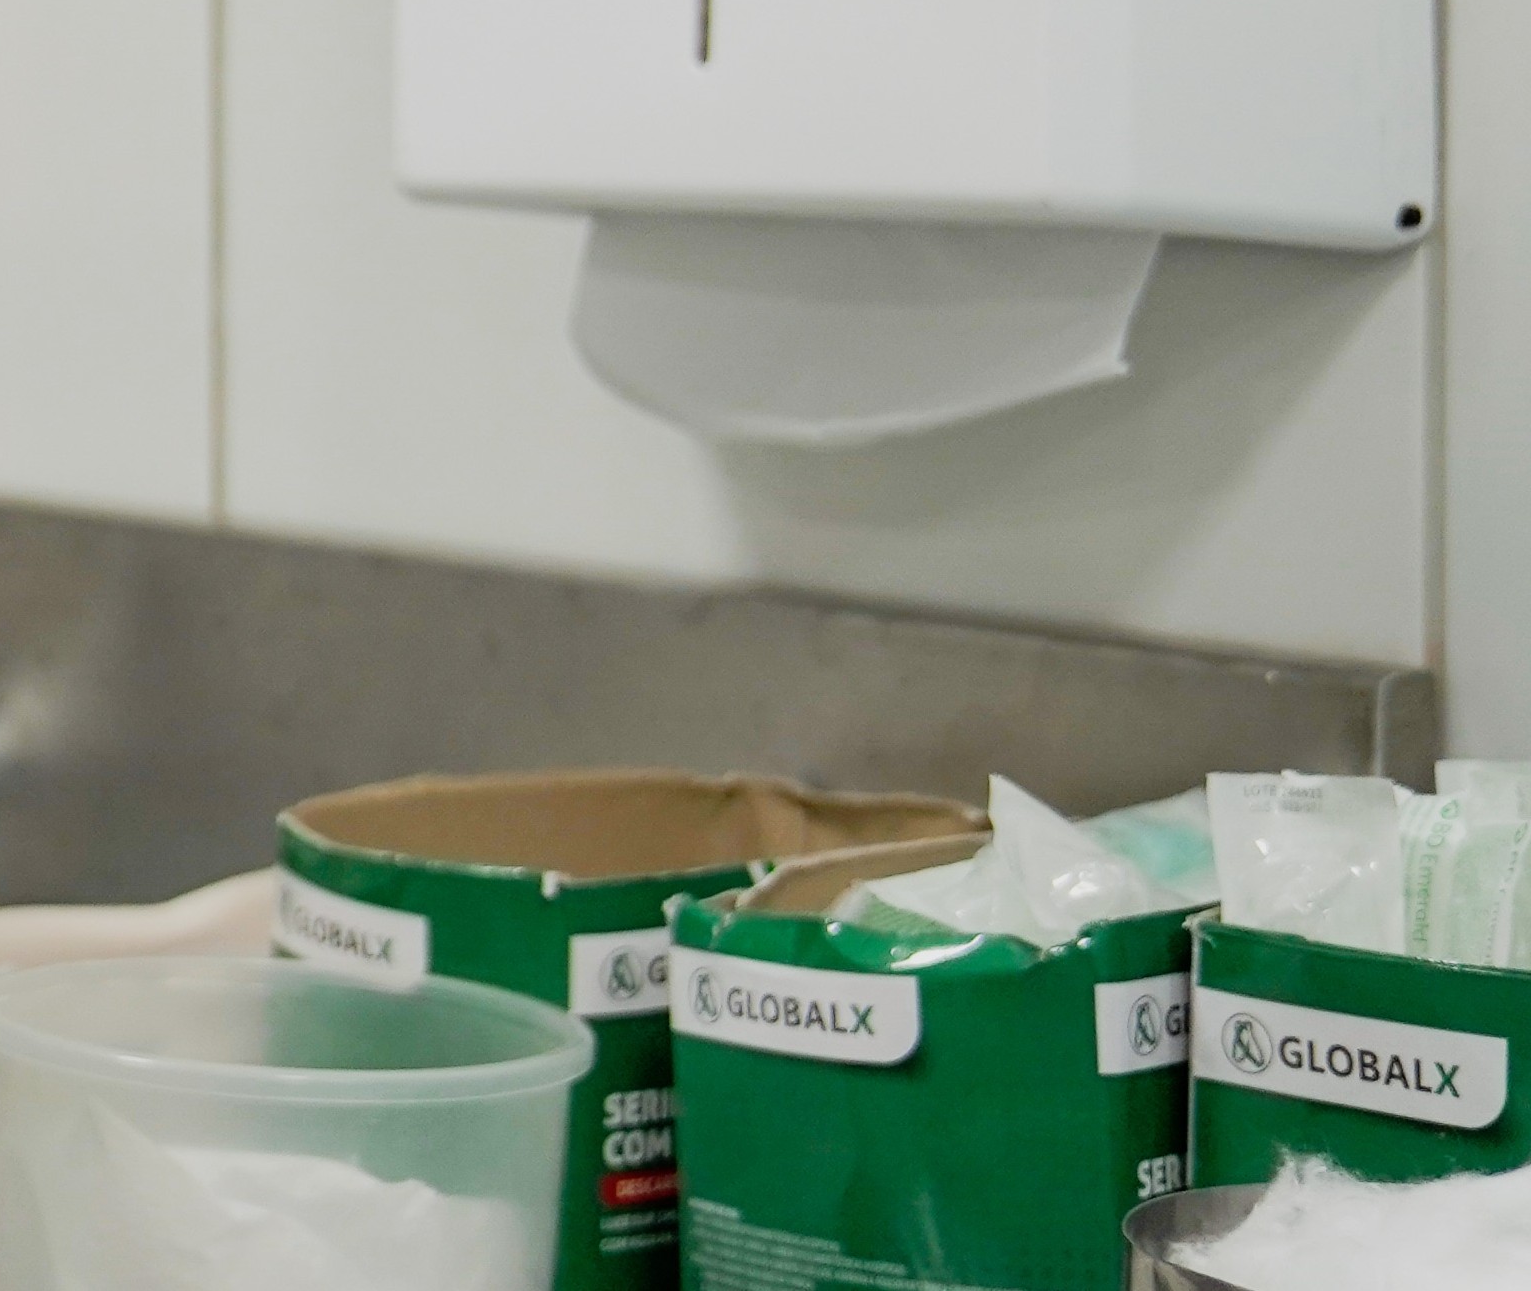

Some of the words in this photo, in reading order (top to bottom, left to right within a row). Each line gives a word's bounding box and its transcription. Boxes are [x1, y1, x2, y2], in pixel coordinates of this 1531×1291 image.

[1412, 854, 1438, 942] Emerald
[726, 987, 875, 1035] GLOBALX
[1279, 1036, 1461, 1098] GLOBALX
